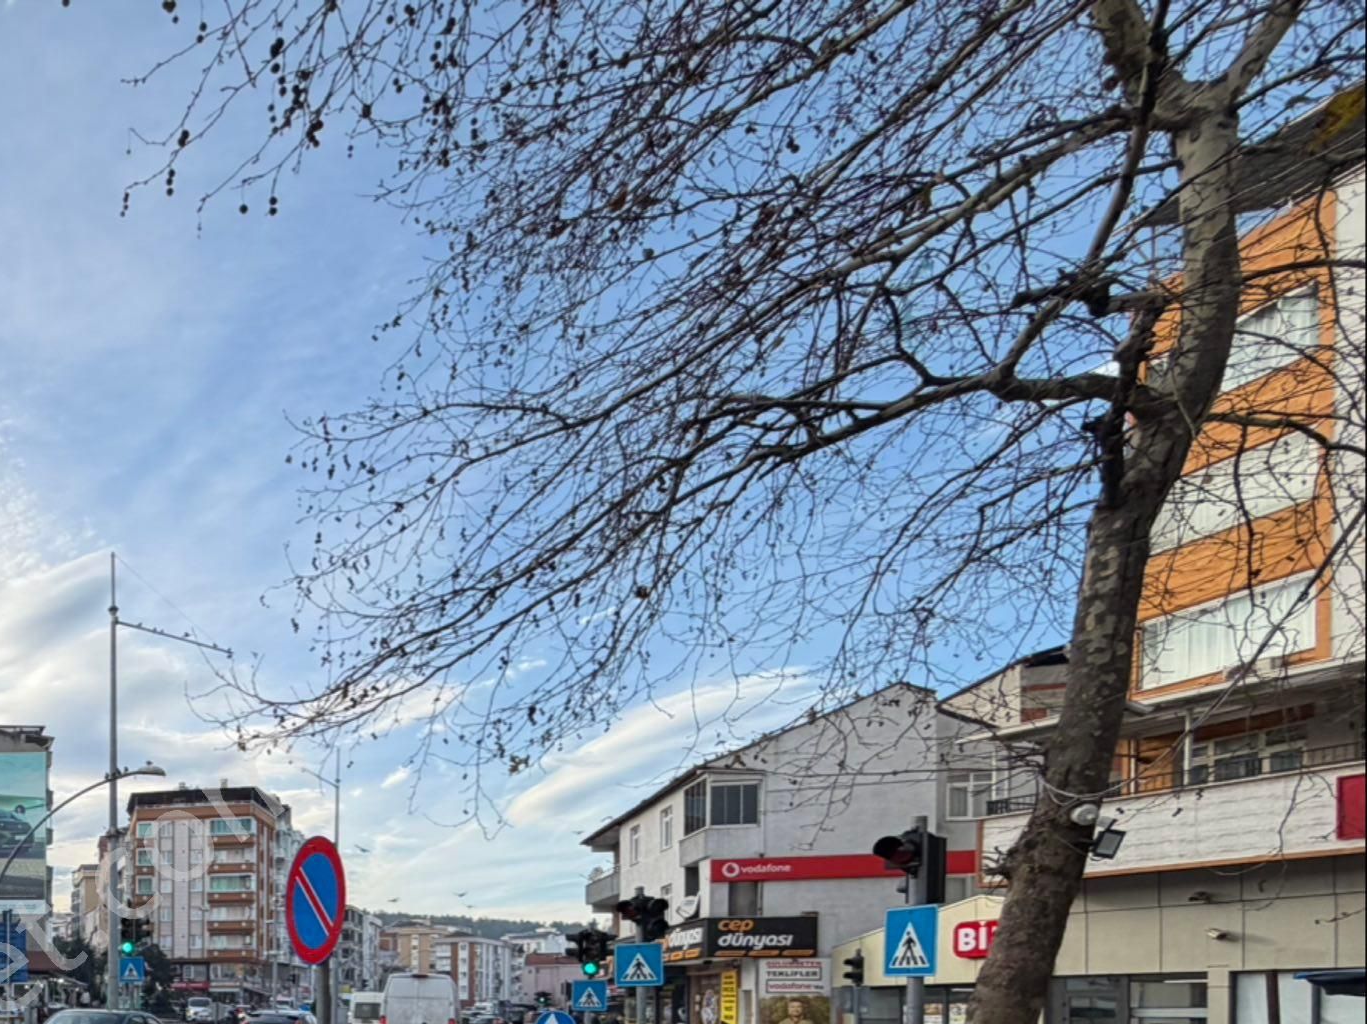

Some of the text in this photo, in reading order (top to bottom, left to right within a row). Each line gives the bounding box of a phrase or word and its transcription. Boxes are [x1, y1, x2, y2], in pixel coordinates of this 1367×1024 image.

[740, 863, 792, 874] vodafone
[717, 919, 754, 933] cep
[717, 933, 794, 950] dünyası
[957, 920, 998, 952] Bİ
